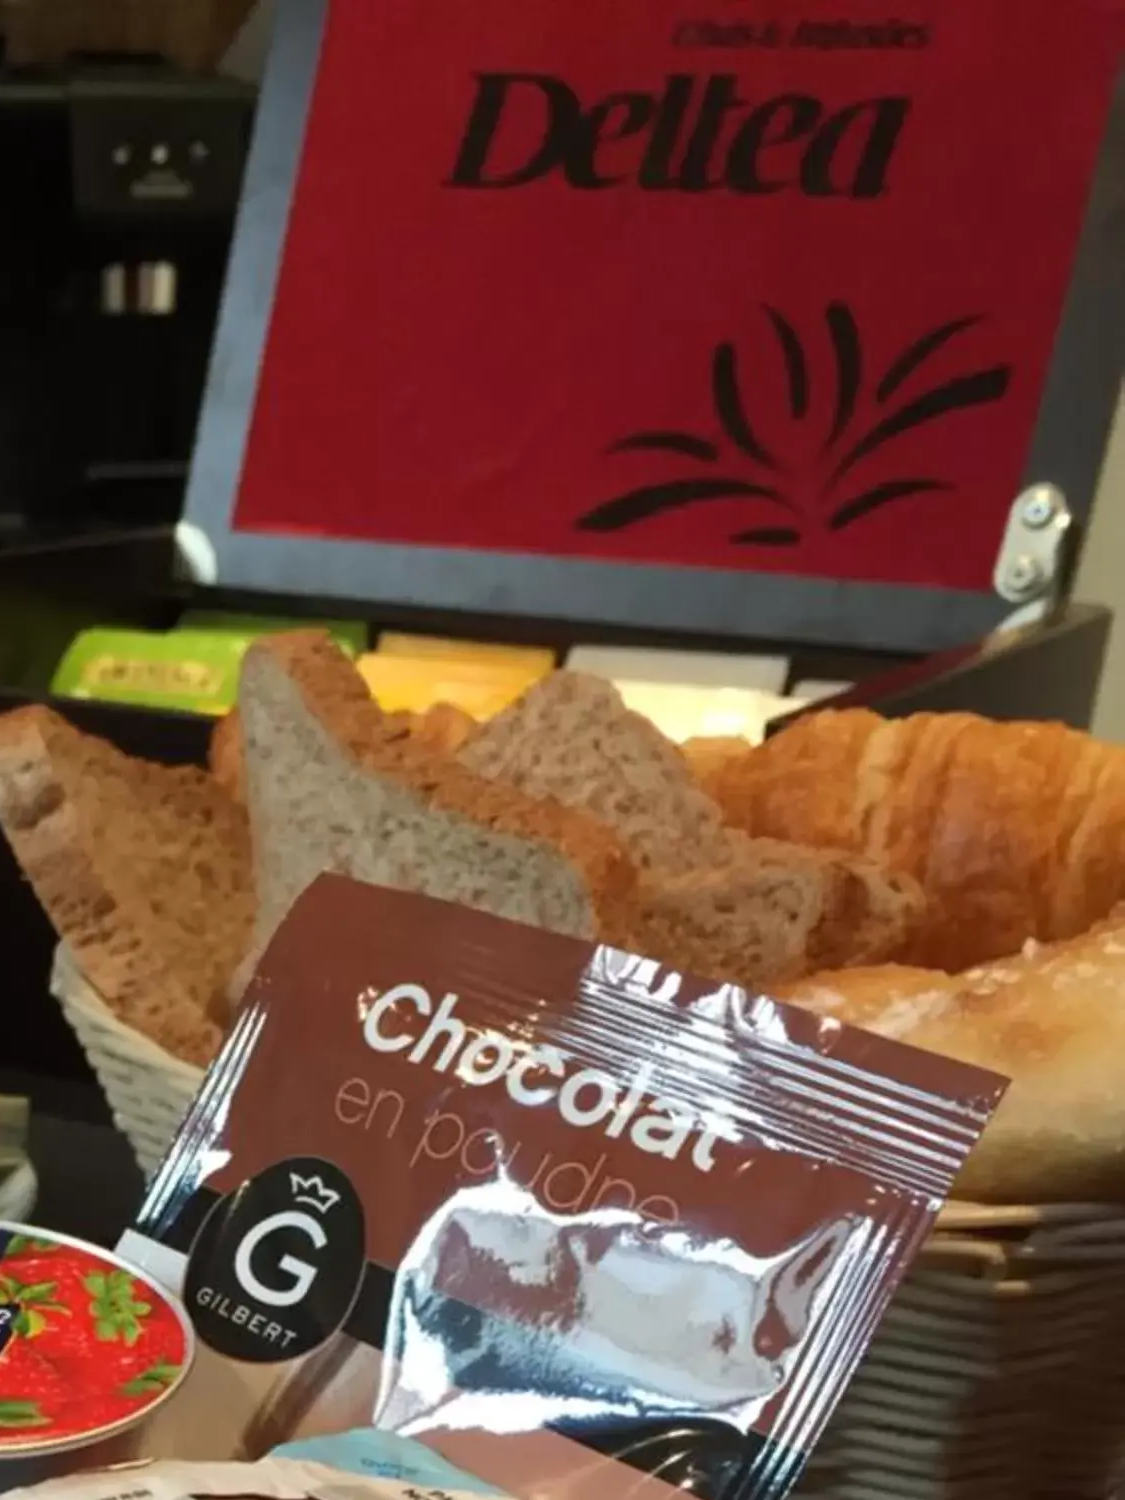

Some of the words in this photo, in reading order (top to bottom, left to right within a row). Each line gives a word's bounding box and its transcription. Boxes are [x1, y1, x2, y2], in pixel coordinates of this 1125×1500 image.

[440, 70, 913, 198] Deltea
[334, 1076, 403, 1133] en
[361, 981, 739, 1173] Chocolat
[234, 1212, 327, 1307] G
[195, 1285, 298, 1350] GILBERT
